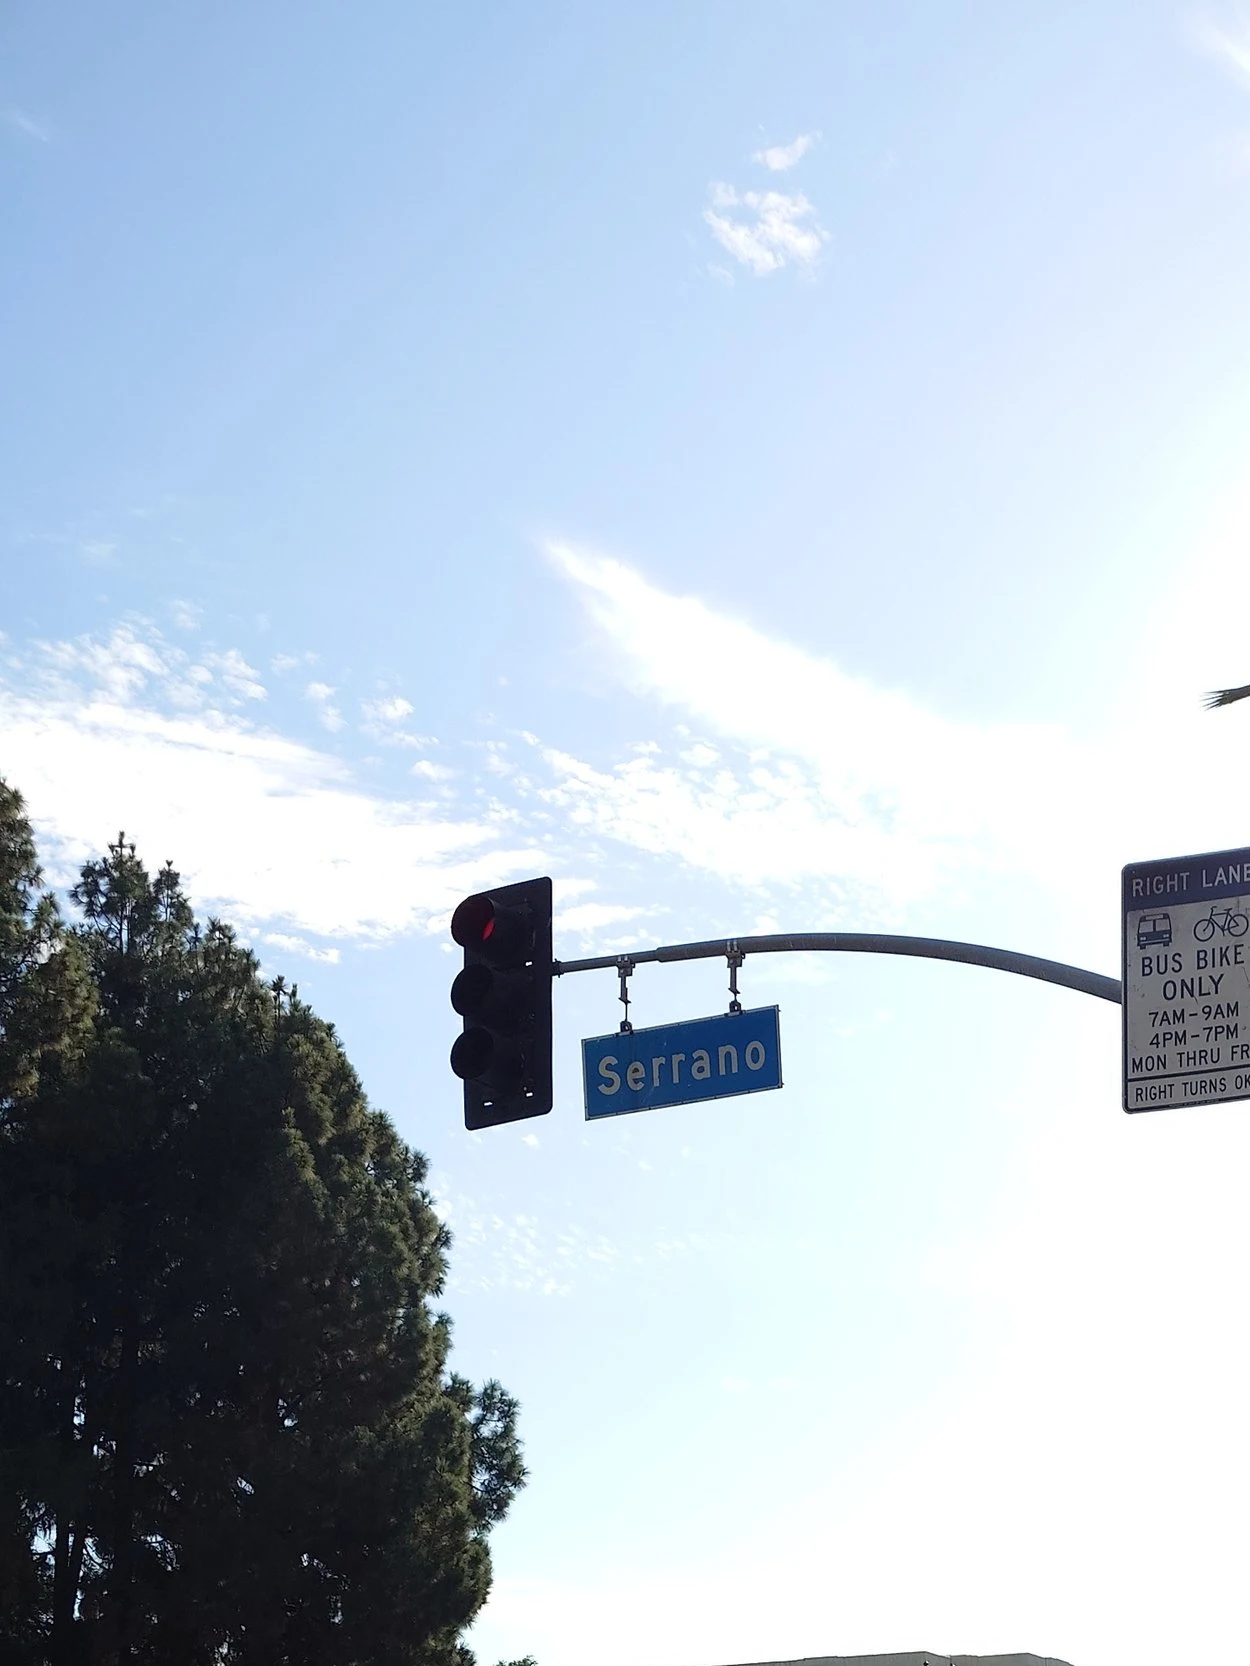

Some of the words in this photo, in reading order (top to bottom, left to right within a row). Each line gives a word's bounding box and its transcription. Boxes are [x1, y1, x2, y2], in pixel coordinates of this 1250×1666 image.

[1132, 872, 1190, 897] RIGHT
[1141, 952, 1183, 977] BUS
[1196, 944, 1245, 970] BIKE
[1163, 973, 1224, 1000] ONLY
[598, 1040, 766, 1096] Serrano
[1131, 1054, 1167, 1073] MON
[1177, 1047, 1220, 1068] THRU
[1135, 1083, 1175, 1102] RIGHT
[1182, 1077, 1227, 1097] TURNS
